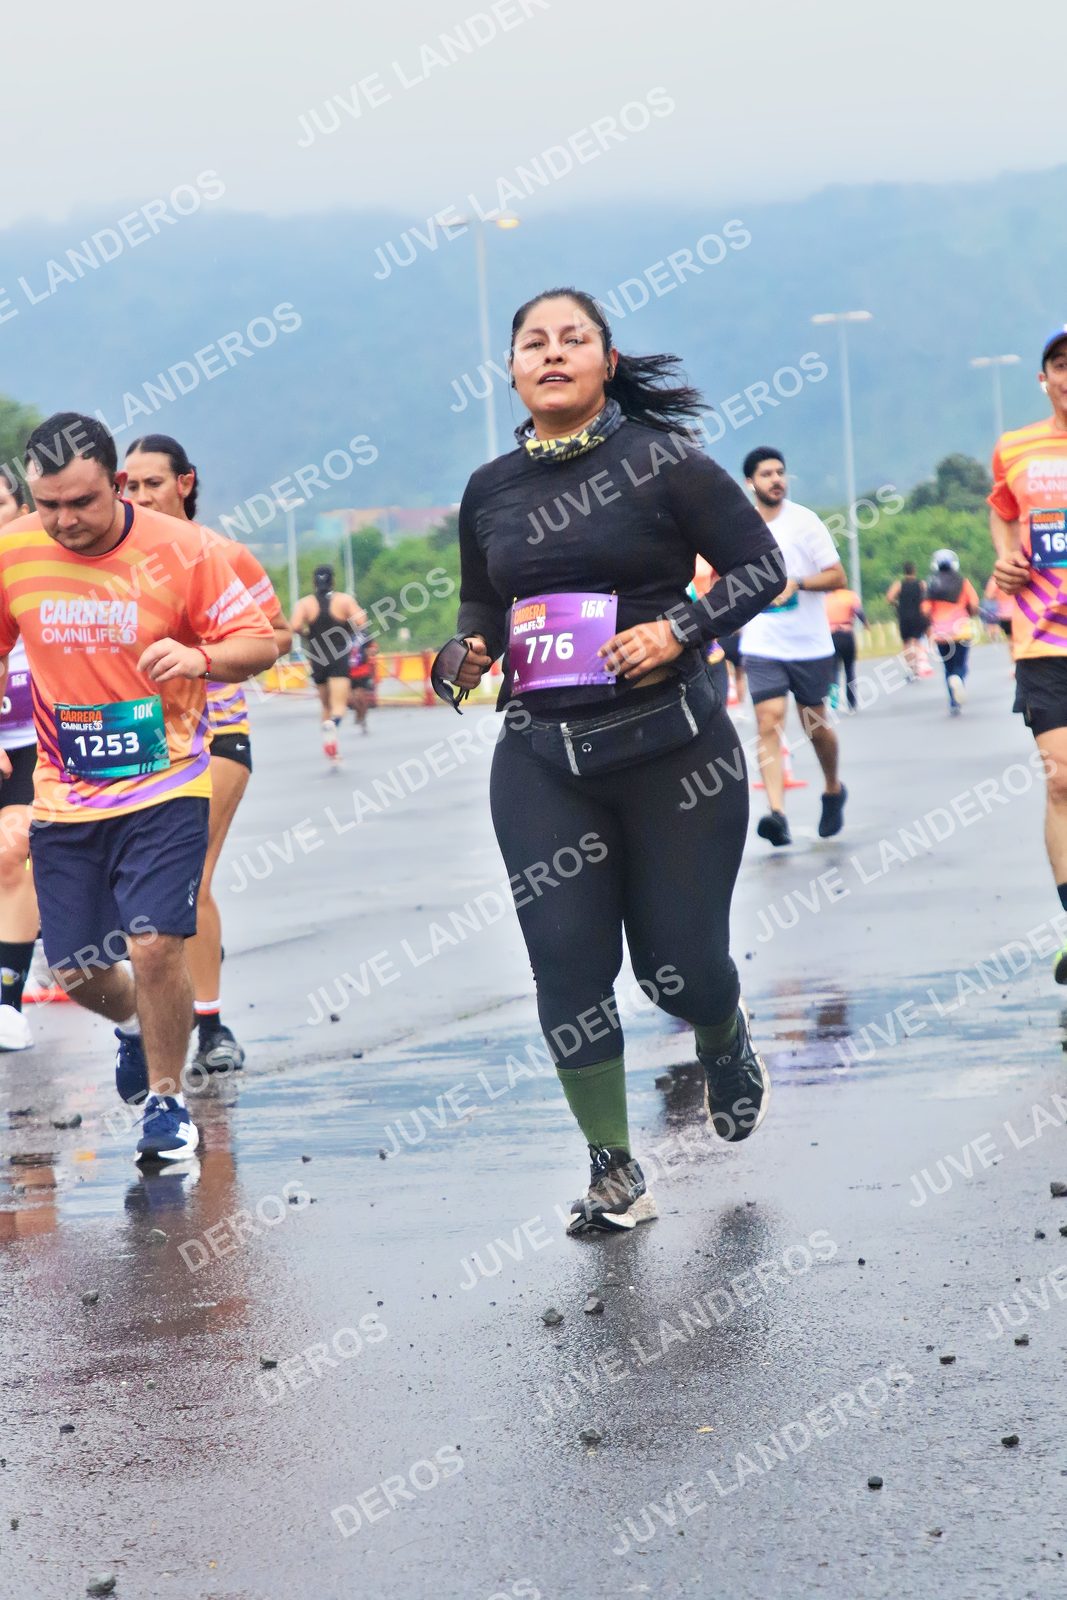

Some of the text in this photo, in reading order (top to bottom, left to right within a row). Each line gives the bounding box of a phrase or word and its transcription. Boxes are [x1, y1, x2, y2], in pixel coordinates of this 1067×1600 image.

[40, 599, 138, 625] CARRERA
[42, 628, 116, 643] OMNILIFE
[525, 633, 574, 664] 776
[60, 710, 102, 722] CARRERA
[133, 703, 153, 720] 10K
[61, 722, 93, 731] OMNILIFE
[74, 732, 140, 757] 1253
